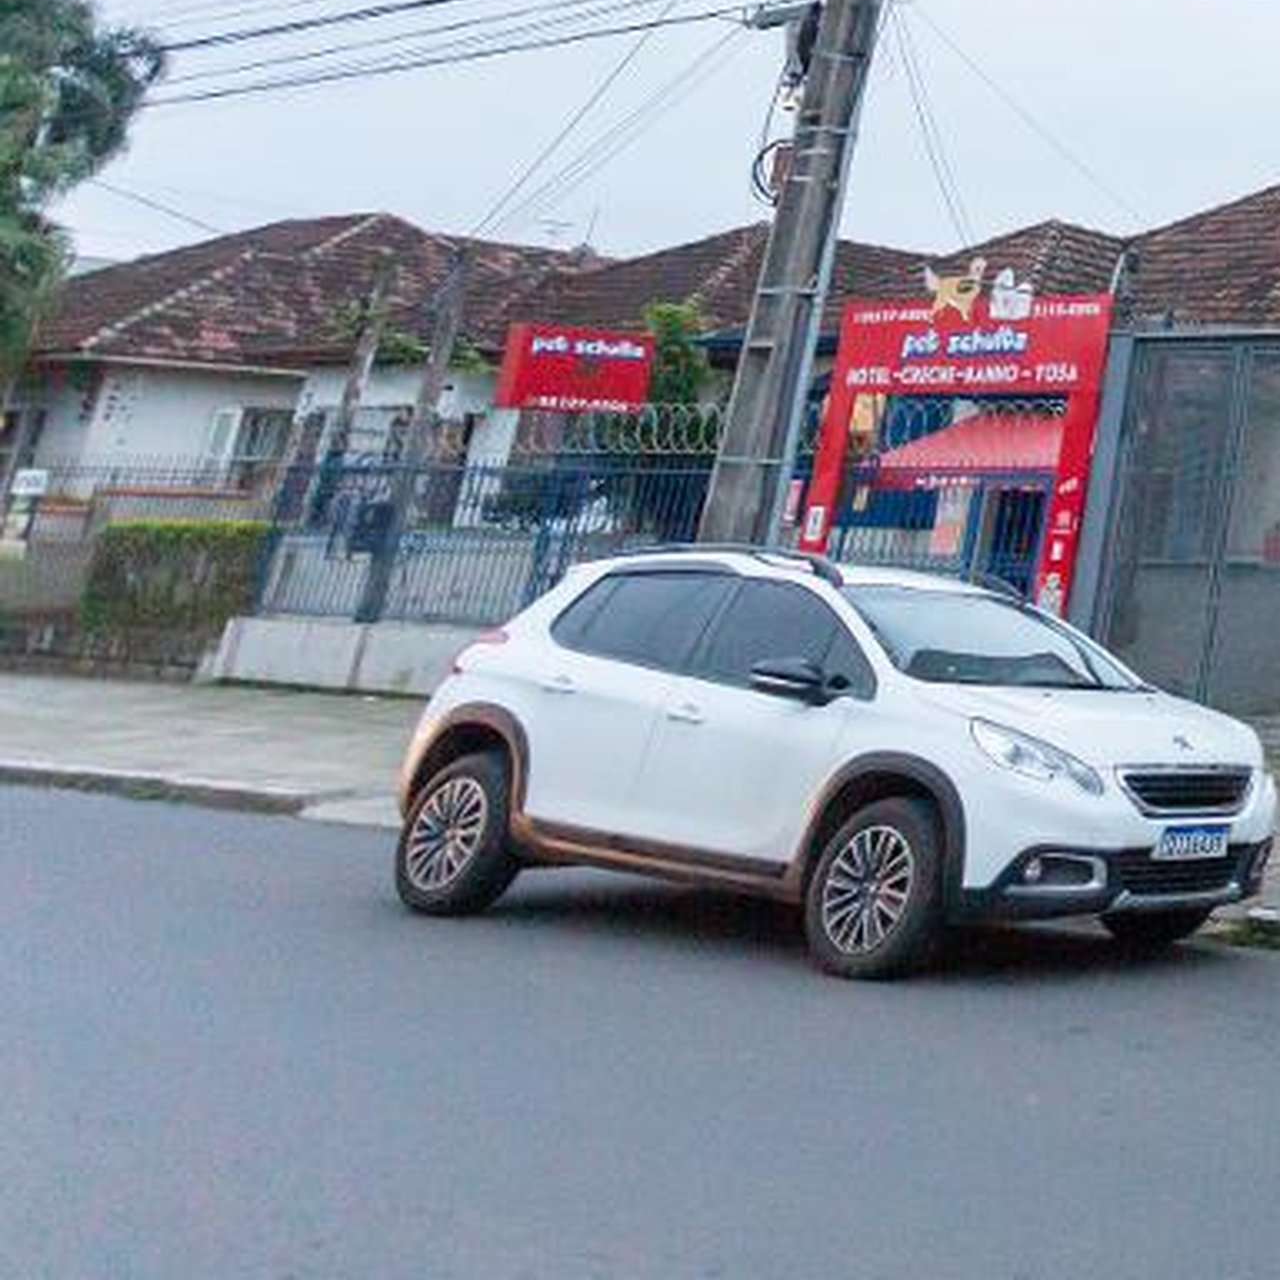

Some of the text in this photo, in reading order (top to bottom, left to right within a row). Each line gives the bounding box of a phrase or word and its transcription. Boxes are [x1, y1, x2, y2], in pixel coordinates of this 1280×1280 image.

[901, 329, 940, 358] pet
[846, 366, 890, 386] HOTEL
[1034, 362, 1079, 382] TOSA
